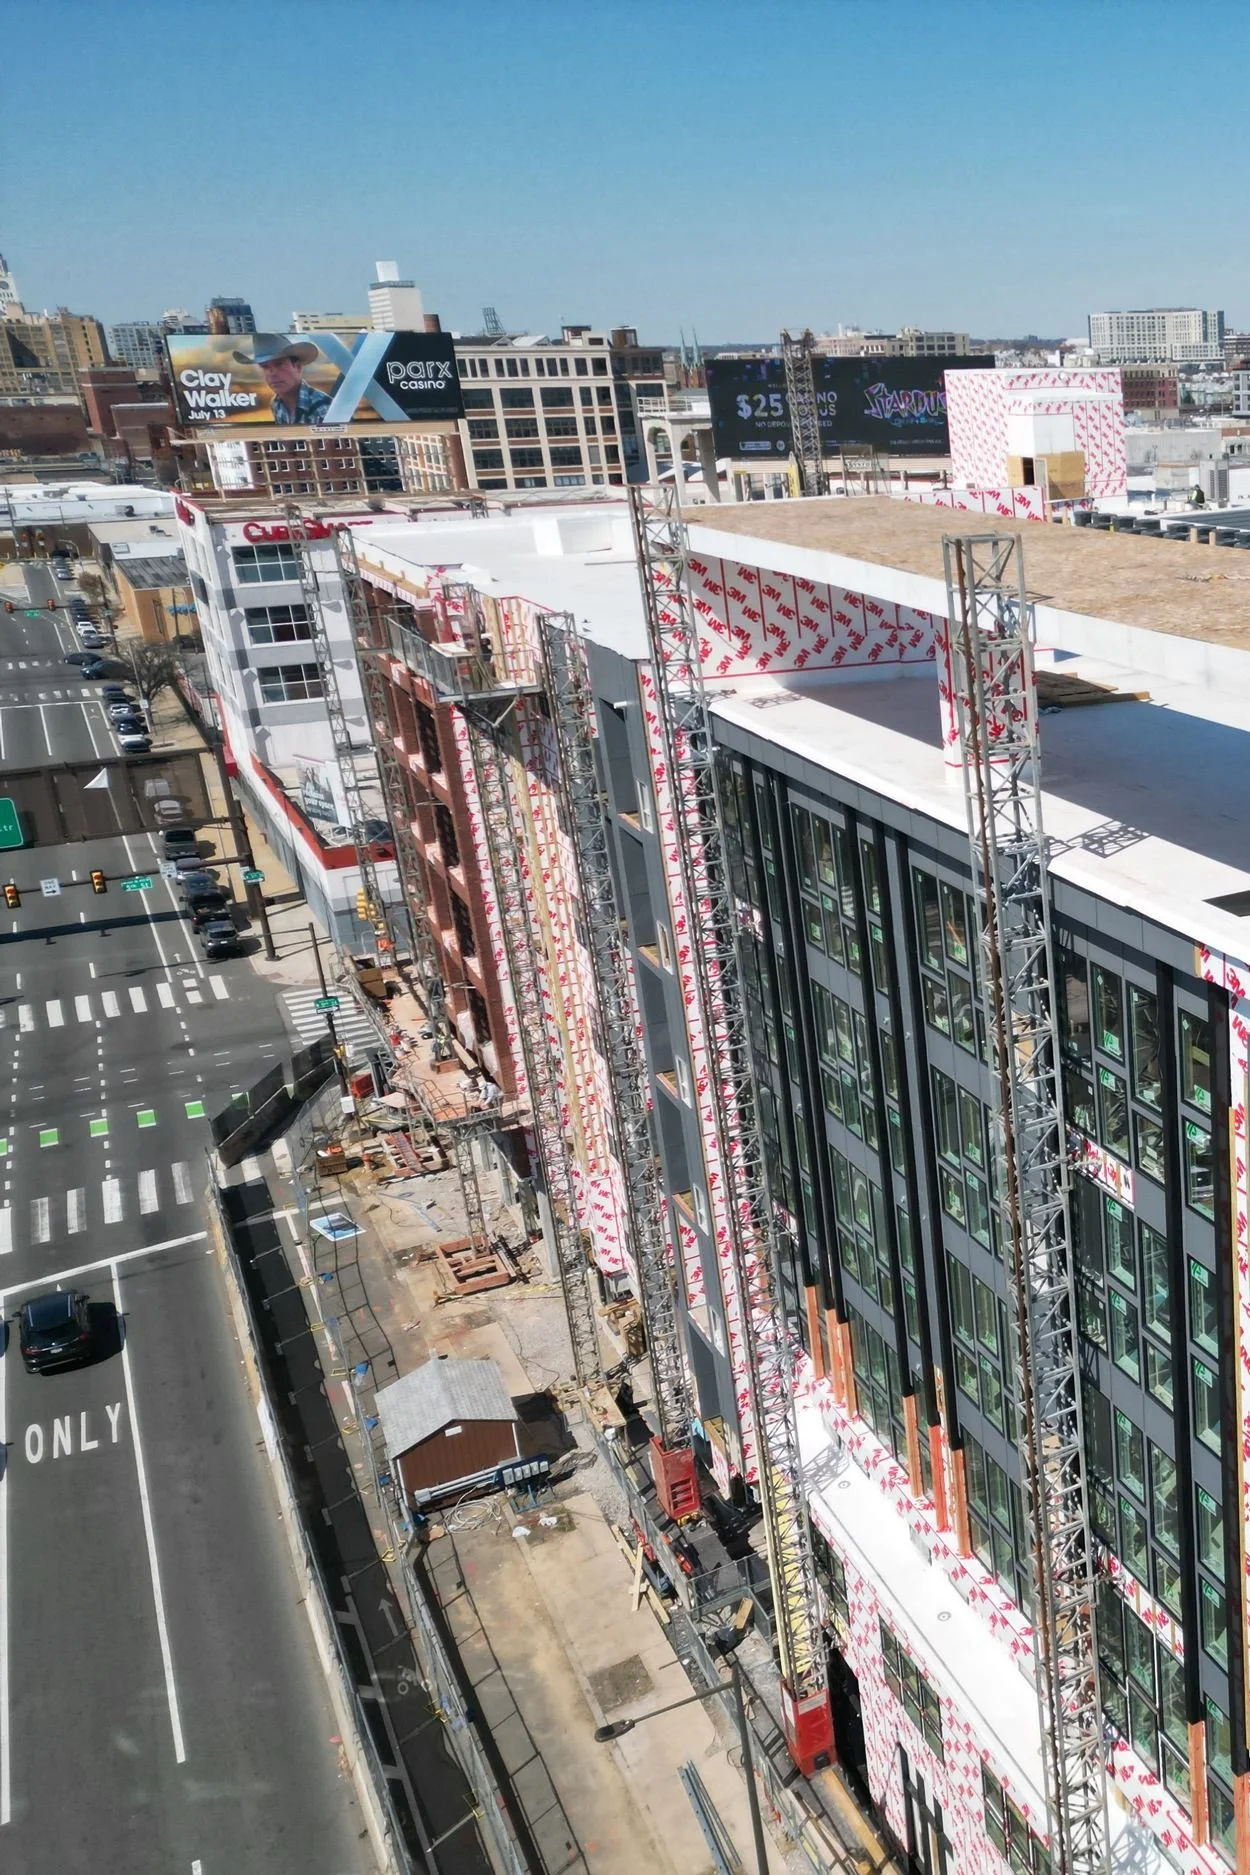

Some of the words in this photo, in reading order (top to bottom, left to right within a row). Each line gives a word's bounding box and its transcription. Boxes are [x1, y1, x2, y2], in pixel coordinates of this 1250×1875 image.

[180, 369, 232, 389] Clay
[385, 360, 453, 384] parx
[399, 379, 445, 390] casino
[183, 391, 257, 408] Walker
[736, 393, 784, 419] $25
[188, 410, 211, 421] July
[214, 409, 226, 419] 13
[25, 1402, 121, 1464] ONLY
